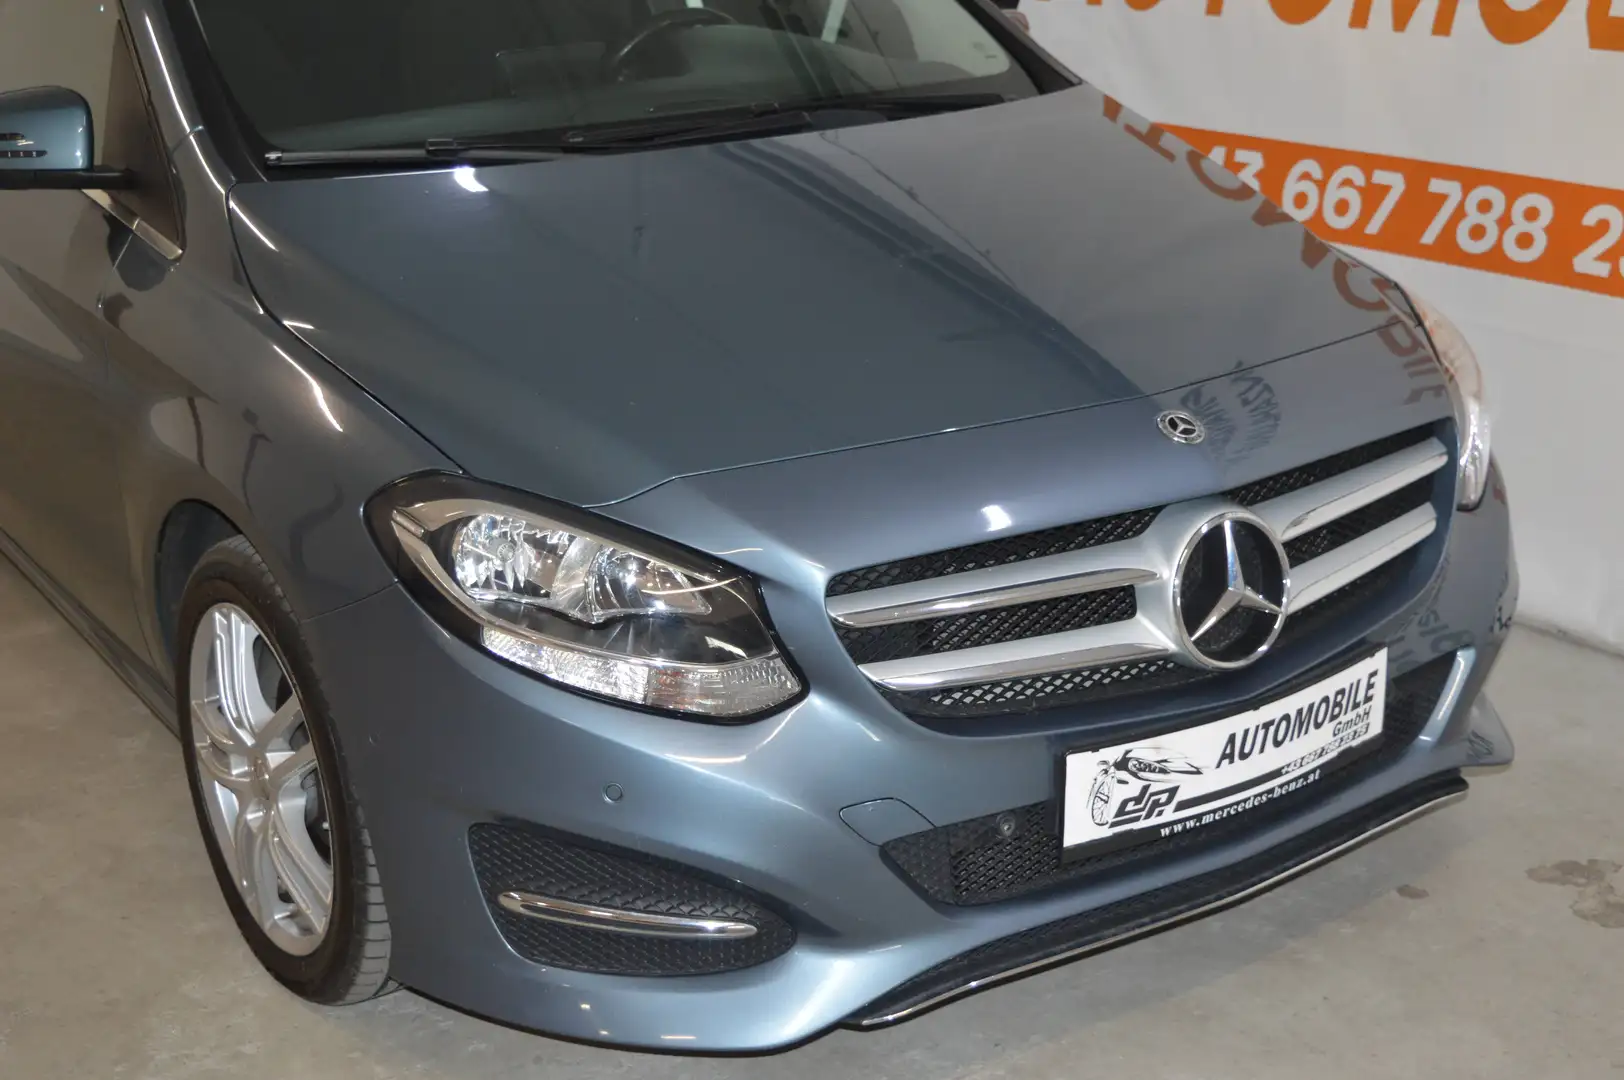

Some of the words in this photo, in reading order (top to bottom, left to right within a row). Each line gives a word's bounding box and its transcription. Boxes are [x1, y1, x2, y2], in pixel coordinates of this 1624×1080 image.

[1281, 158, 1406, 236] 667
[1419, 177, 1555, 263] 788
[1571, 203, 1624, 279] 2
[1215, 668, 1379, 769] AUTOMOBILE
[1332, 705, 1372, 738] GmbH
[1160, 769, 1321, 838] www.mercedes-benz.at
